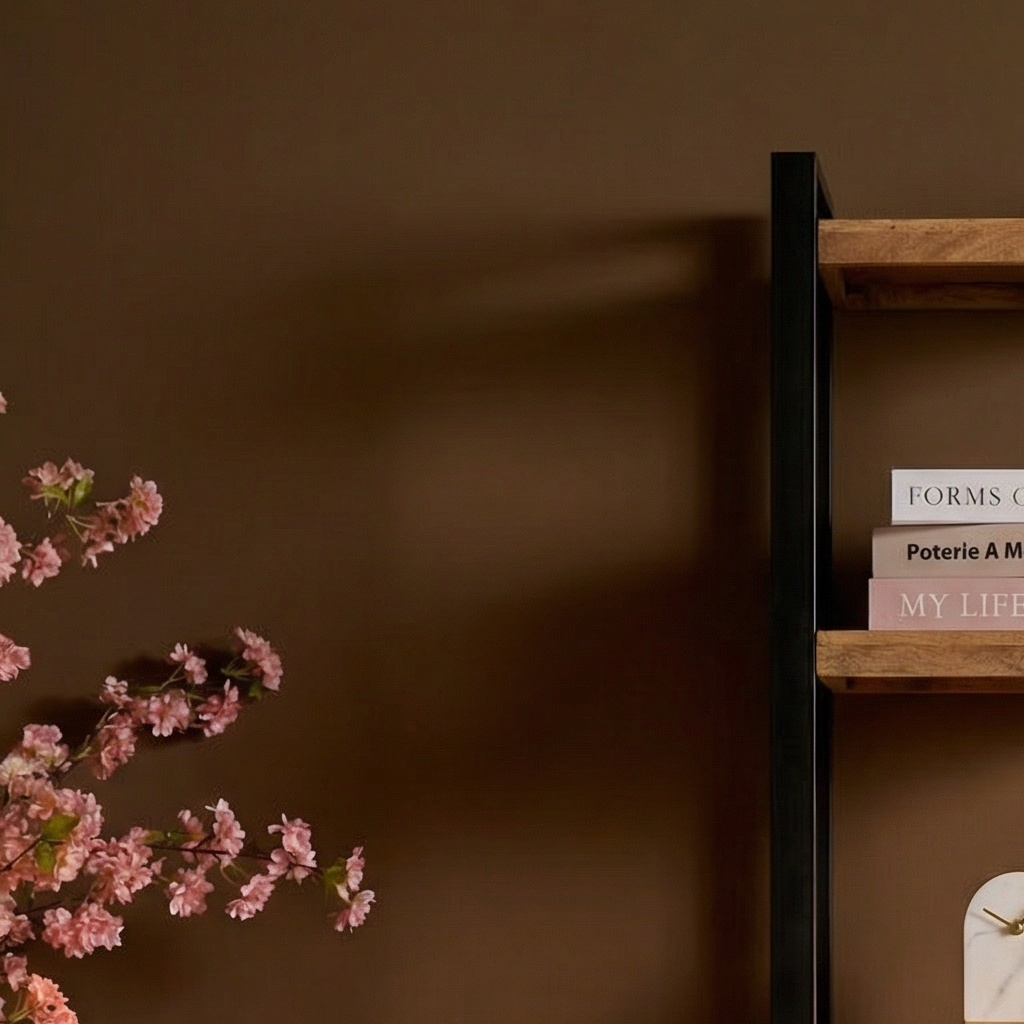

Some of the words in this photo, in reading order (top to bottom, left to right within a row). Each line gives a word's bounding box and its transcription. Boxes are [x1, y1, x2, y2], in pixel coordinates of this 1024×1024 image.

[908, 486, 1001, 507] FORMS
[906, 542, 980, 561] Poterie
[985, 543, 999, 560] A
[899, 593, 950, 618] MY
